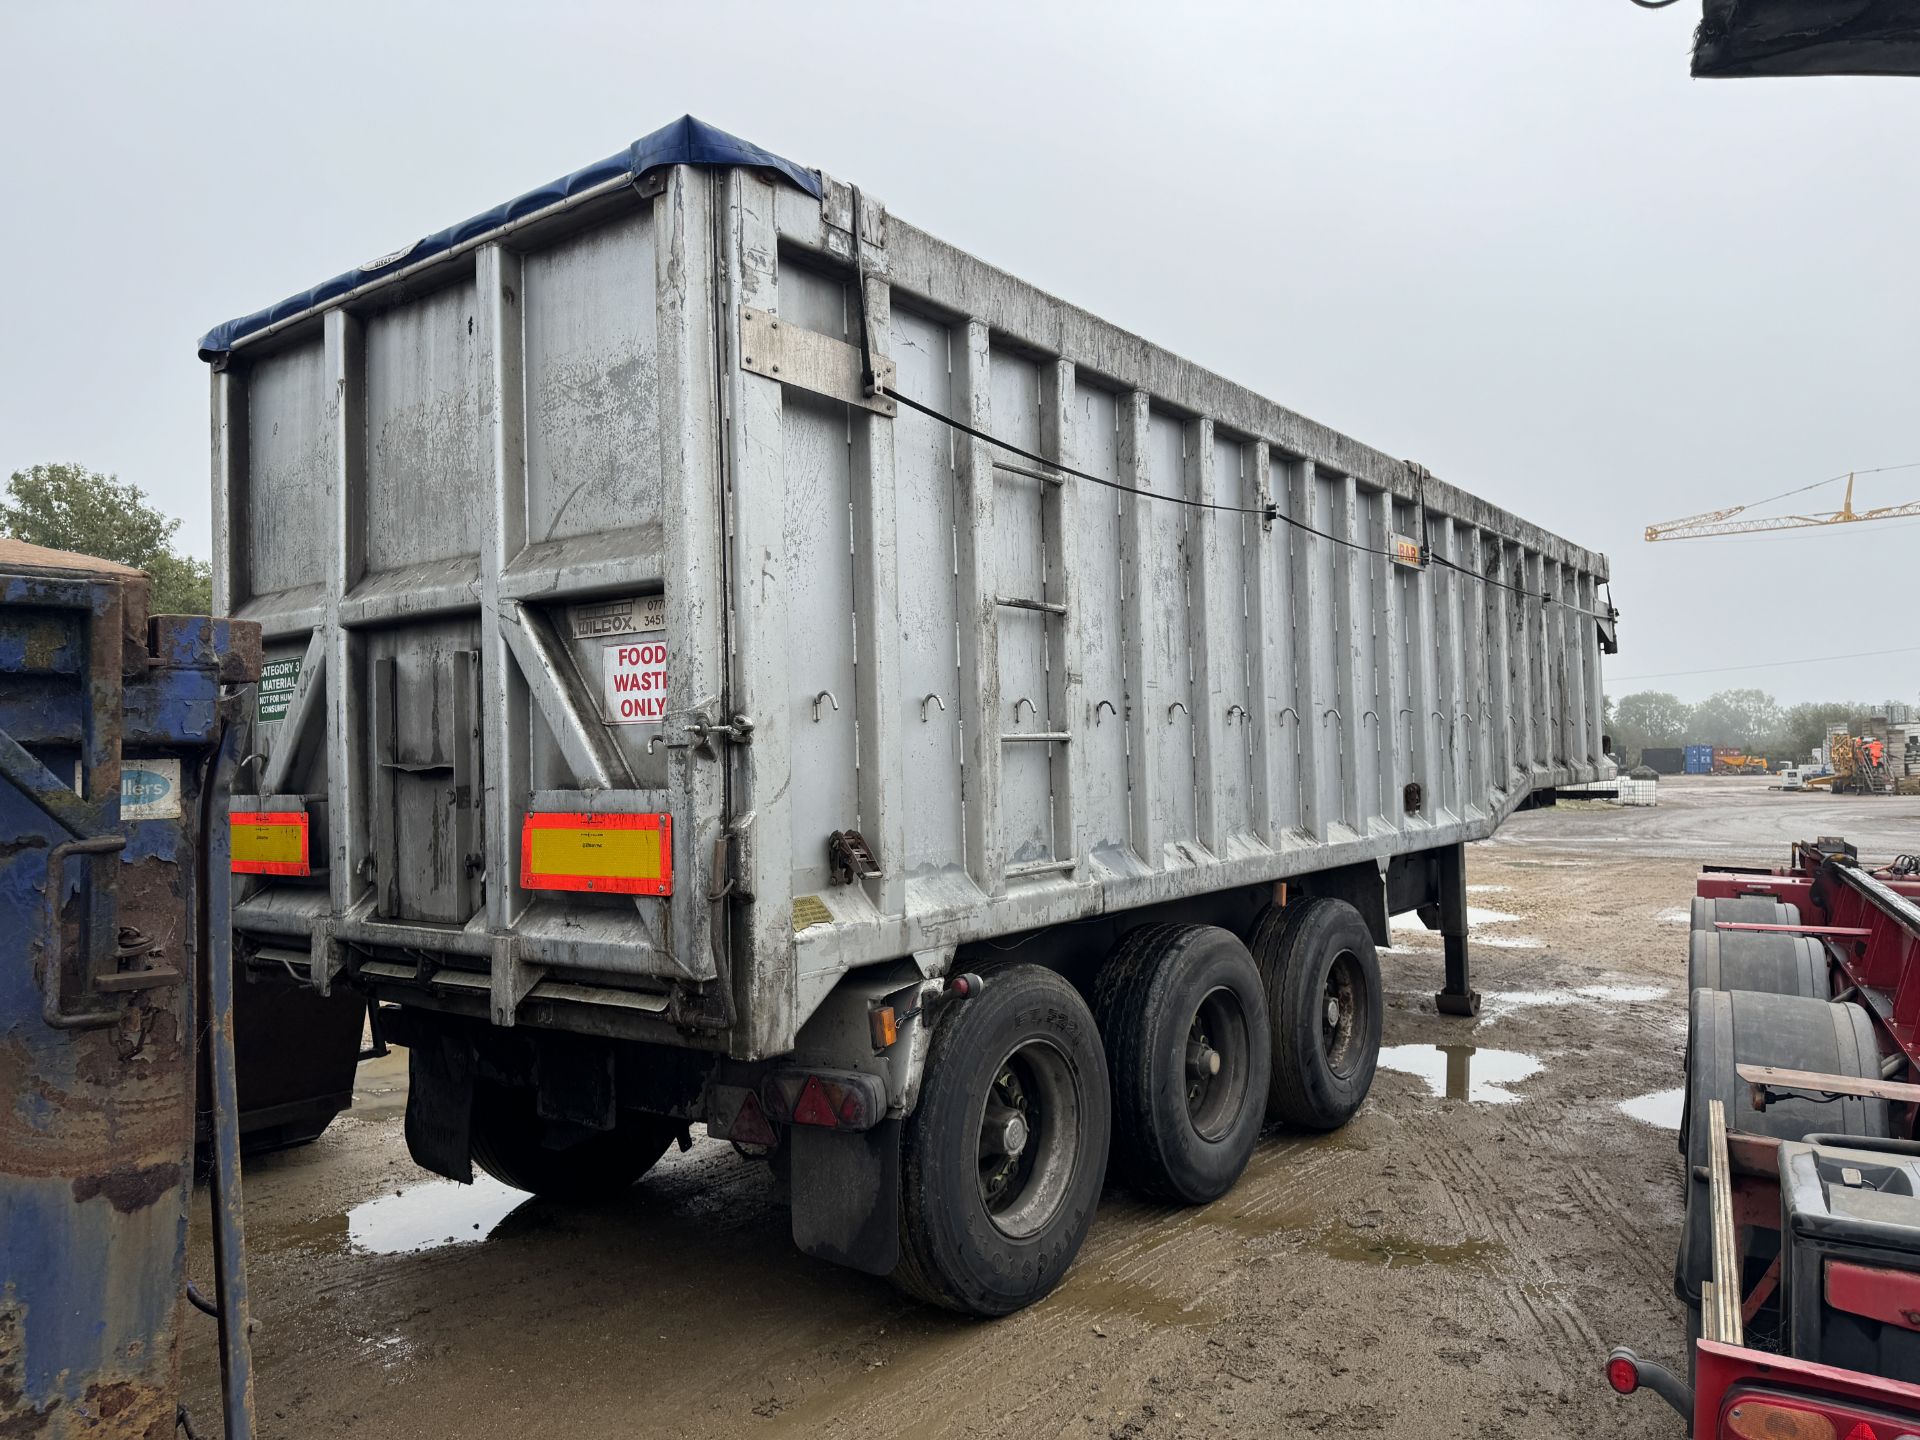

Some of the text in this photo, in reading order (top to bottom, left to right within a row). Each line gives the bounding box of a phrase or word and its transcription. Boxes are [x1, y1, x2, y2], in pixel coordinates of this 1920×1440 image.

[619, 646, 666, 666] FOOD
[295, 662, 300, 672] 3
[262, 676, 296, 691] MATERIAL
[259, 695, 270, 705] NOT
[270, 694, 280, 704] FOR
[620, 697, 666, 717] ONLY
